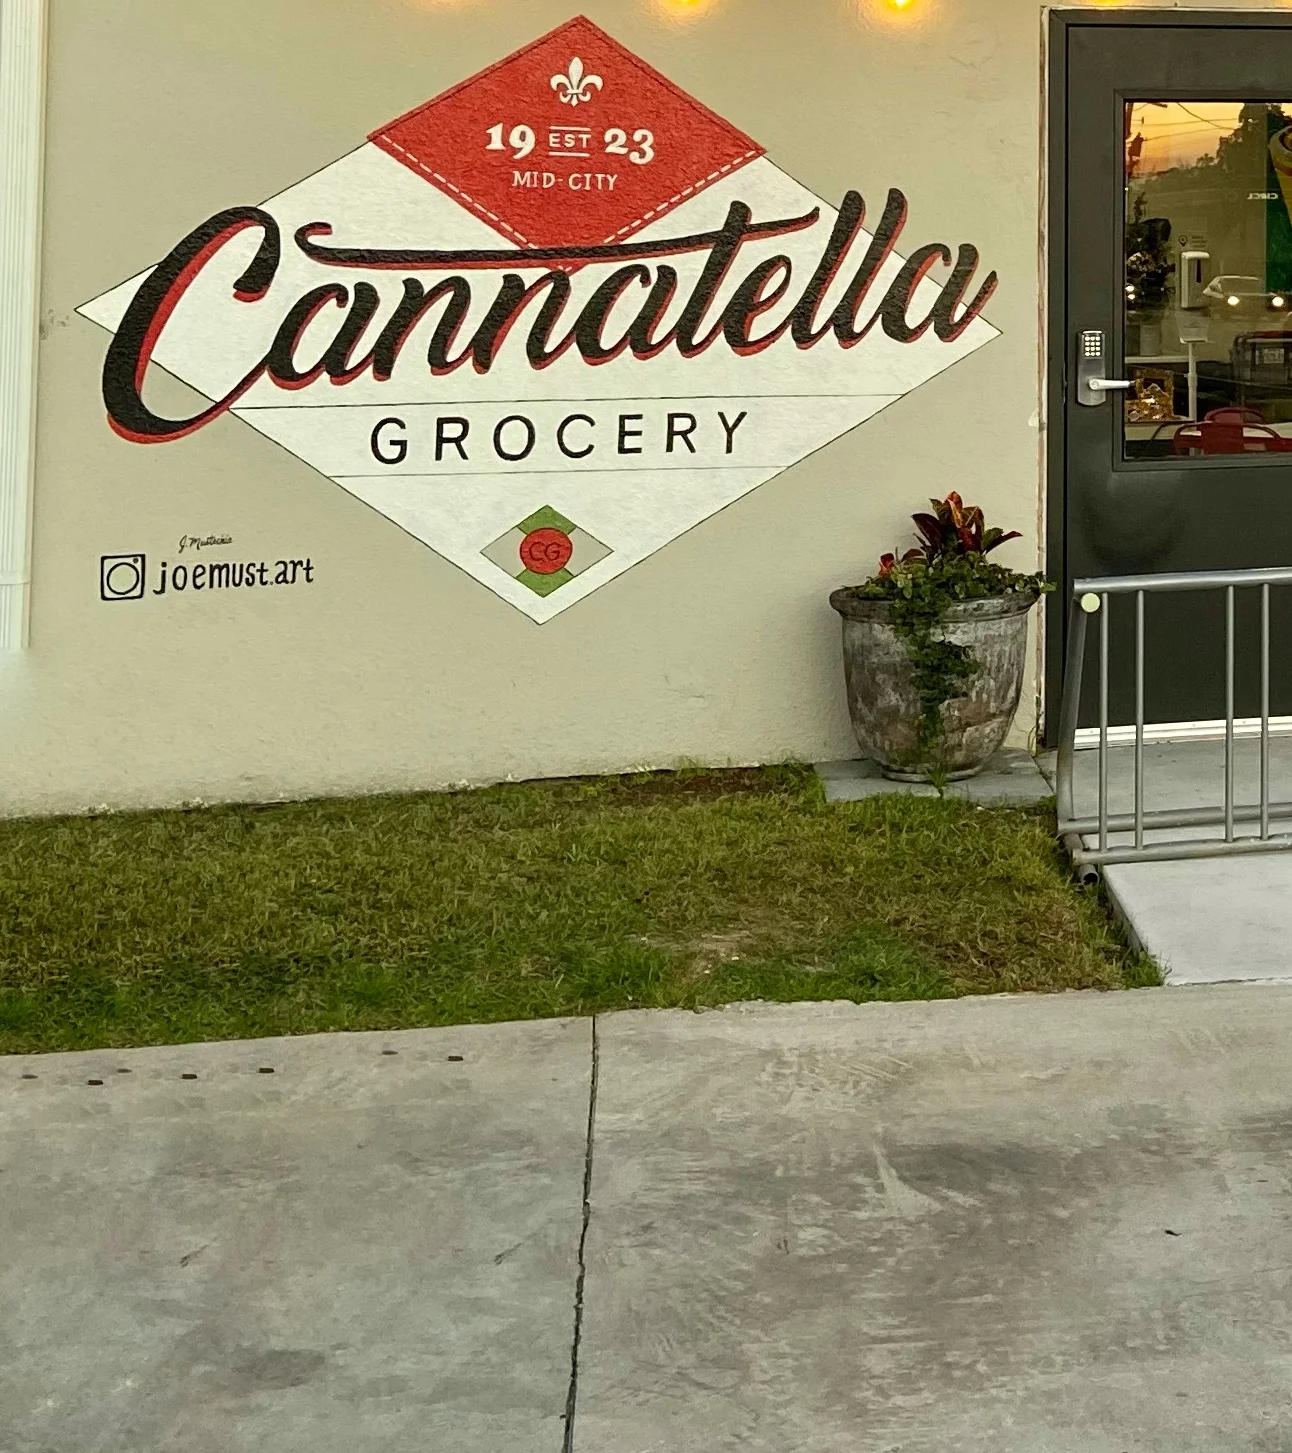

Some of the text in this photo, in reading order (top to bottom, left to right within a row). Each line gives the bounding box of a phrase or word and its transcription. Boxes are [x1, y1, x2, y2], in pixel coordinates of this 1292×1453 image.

[485, 123, 655, 165] 19 EST 23
[511, 170, 619, 191] MID-CITY
[102, 186, 999, 445] Cannatella
[369, 409, 749, 465] GROCERY
[528, 541, 561, 562] CG
[152, 557, 315, 595] joemust.art
